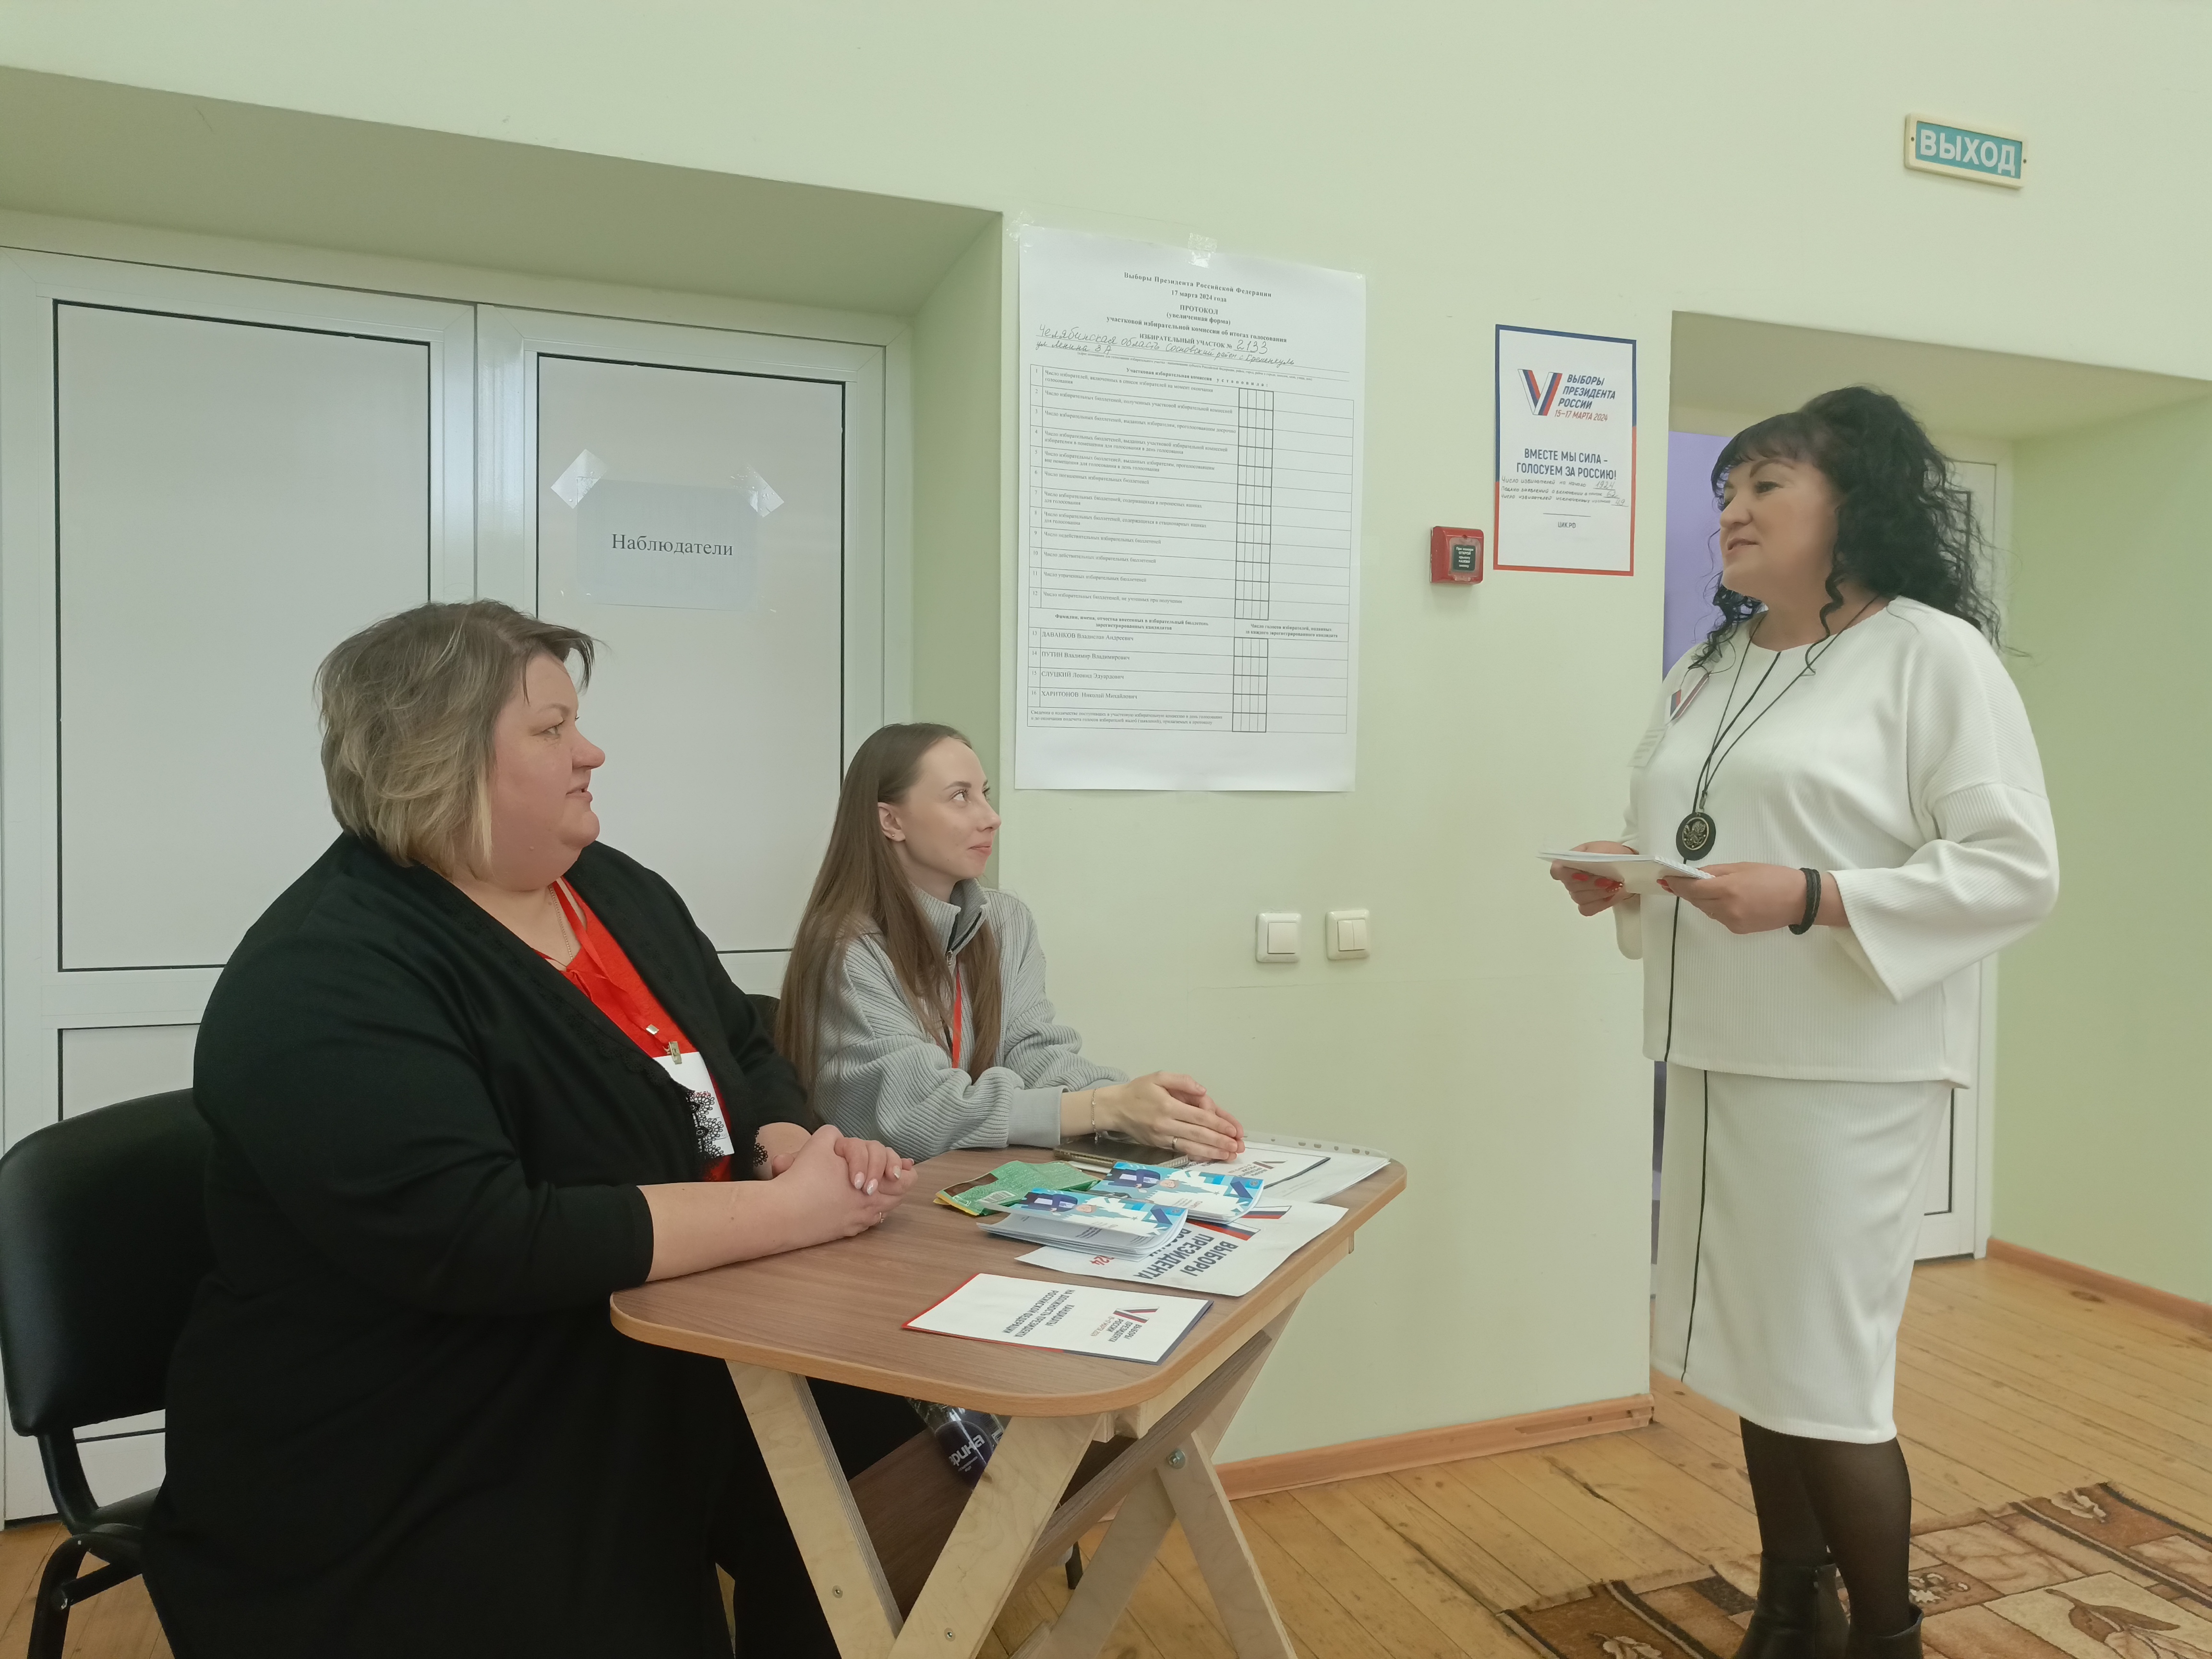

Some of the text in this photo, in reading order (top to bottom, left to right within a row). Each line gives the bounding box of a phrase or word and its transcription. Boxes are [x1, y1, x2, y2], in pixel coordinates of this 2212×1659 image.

[1920, 129, 2015, 176] ВЫХОД
[1124, 272, 1272, 297] Выборы Президента Российской Федерации
[1199, 292, 1213, 301] 2024
[1166, 312, 1231, 325] (увеличенная форма)
[1179, 304, 1218, 314] ПРОТОКОЛ
[1040, 324, 1118, 344] Челябинская
[1106, 316, 1142, 325] участковой
[1143, 320, 1190, 330] избирательной
[1191, 326, 1220, 335] комиссии
[1250, 334, 1287, 343] голосования
[1140, 333, 1195, 344] ИЗБИРАТЕЛЬНЫЙ
[1196, 339, 1226, 348] УЧАСТОК
[1237, 339, 1268, 354] 2133
[1567, 374, 1605, 386] ВЫБОРЫ
[1563, 386, 1616, 399] ПРЕЗИДЕНТА
[1558, 398, 1592, 409] РОССИИ
[1572, 411, 1592, 420] МАРТА
[1593, 413, 1608, 421] 2024
[1524, 448, 1558, 460] ВМЕСТЕ
[1561, 451, 1576, 462] МЫ
[1579, 453, 1601, 464] СИЛА
[1516, 462, 1617, 480] ГОЛОСУЕМ ЗА РОССИЮ!
[611, 533, 733, 556] Наблюдатели
[1133, 1234, 1215, 1279] ПРЕЗИДЕНТА
[1179, 1241, 1239, 1276] ВЫБОРЫ
[1001, 1290, 1059, 1334] РОССИЙСКОЙ ФЕДЕРАЦИИ
[1040, 1294, 1070, 1316] ДОЛЖНОСТЬ
[1045, 1304, 1075, 1326] КАНДИДАТЫ
[1013, 1316, 1046, 1337] ПРЕЗИДЕНТА
[1107, 1321, 1133, 1342] ПРЕЗИДЕНТА
[1123, 1324, 1142, 1339] ВЫБОРЫ
